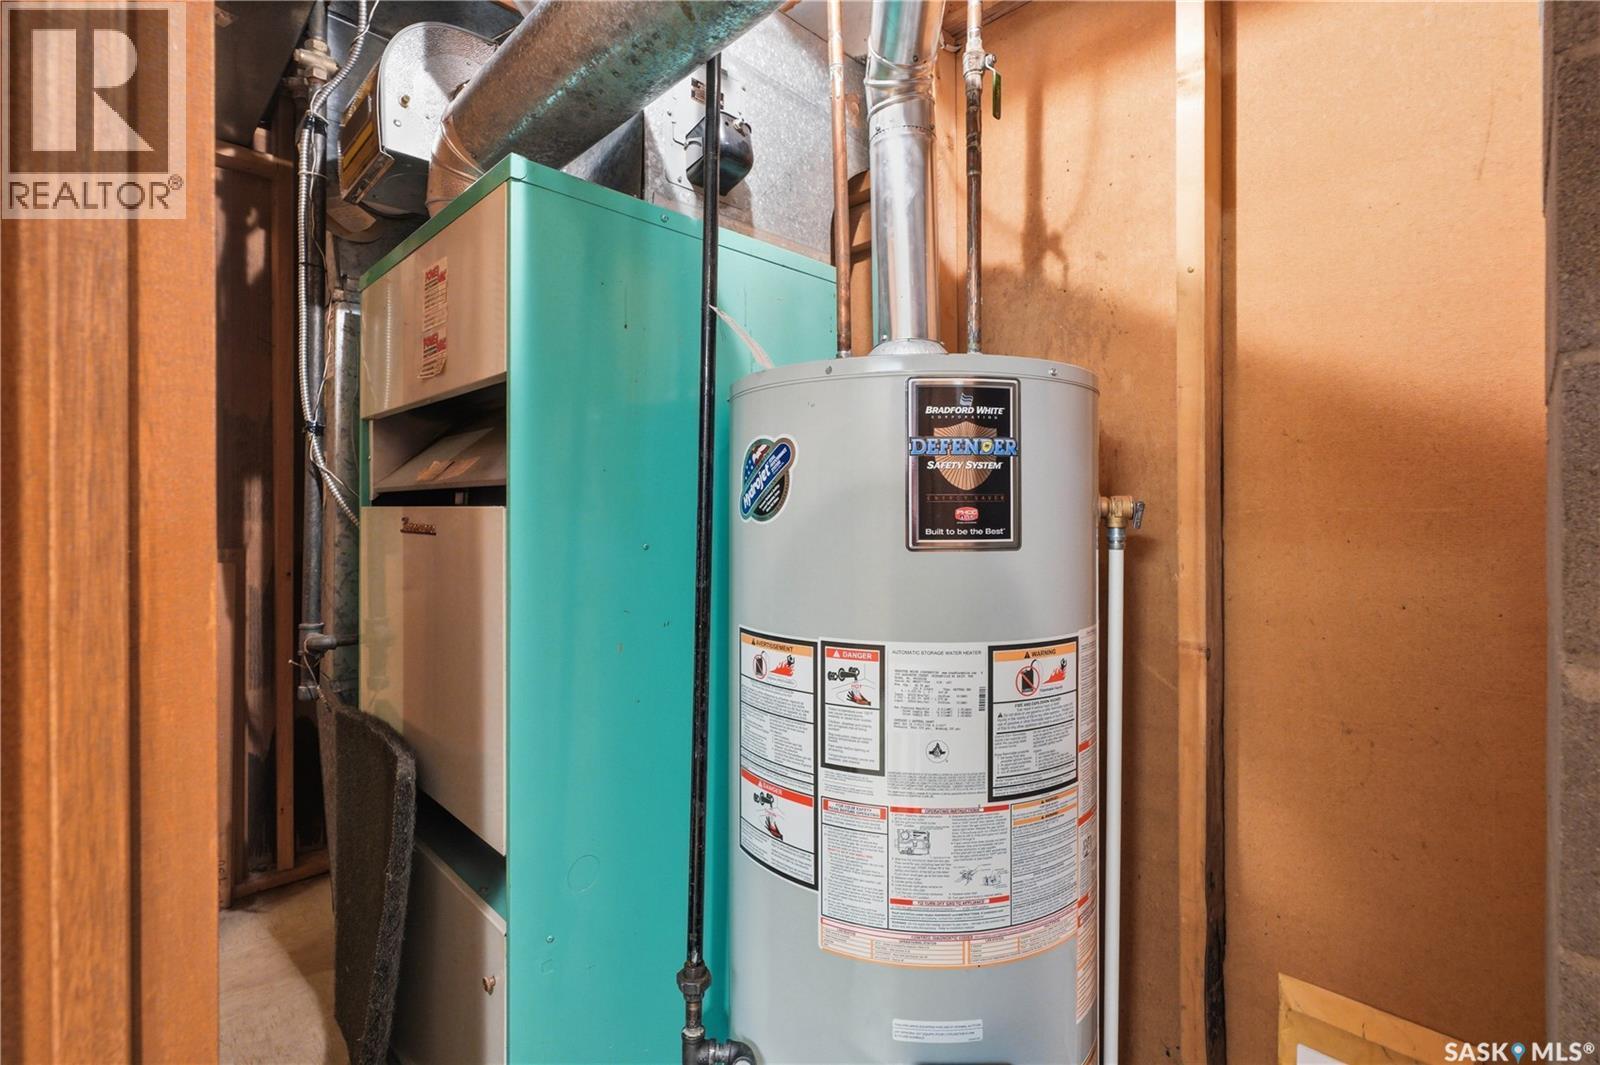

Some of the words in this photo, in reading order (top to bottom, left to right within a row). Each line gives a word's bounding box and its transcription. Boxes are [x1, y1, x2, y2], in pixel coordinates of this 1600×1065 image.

[925, 406, 974, 415] BRADFORD
[976, 407, 1005, 415] WHITE
[910, 437, 1018, 456] DEFENDER
[926, 461, 963, 470] SAFETY
[965, 461, 1003, 470] SYSTEM
[925, 528, 944, 536] Built
[957, 528, 968, 536] be
[970, 528, 983, 536] the
[842, 651, 873, 660] DANGER
[1031, 649, 1057, 658] WARNING
